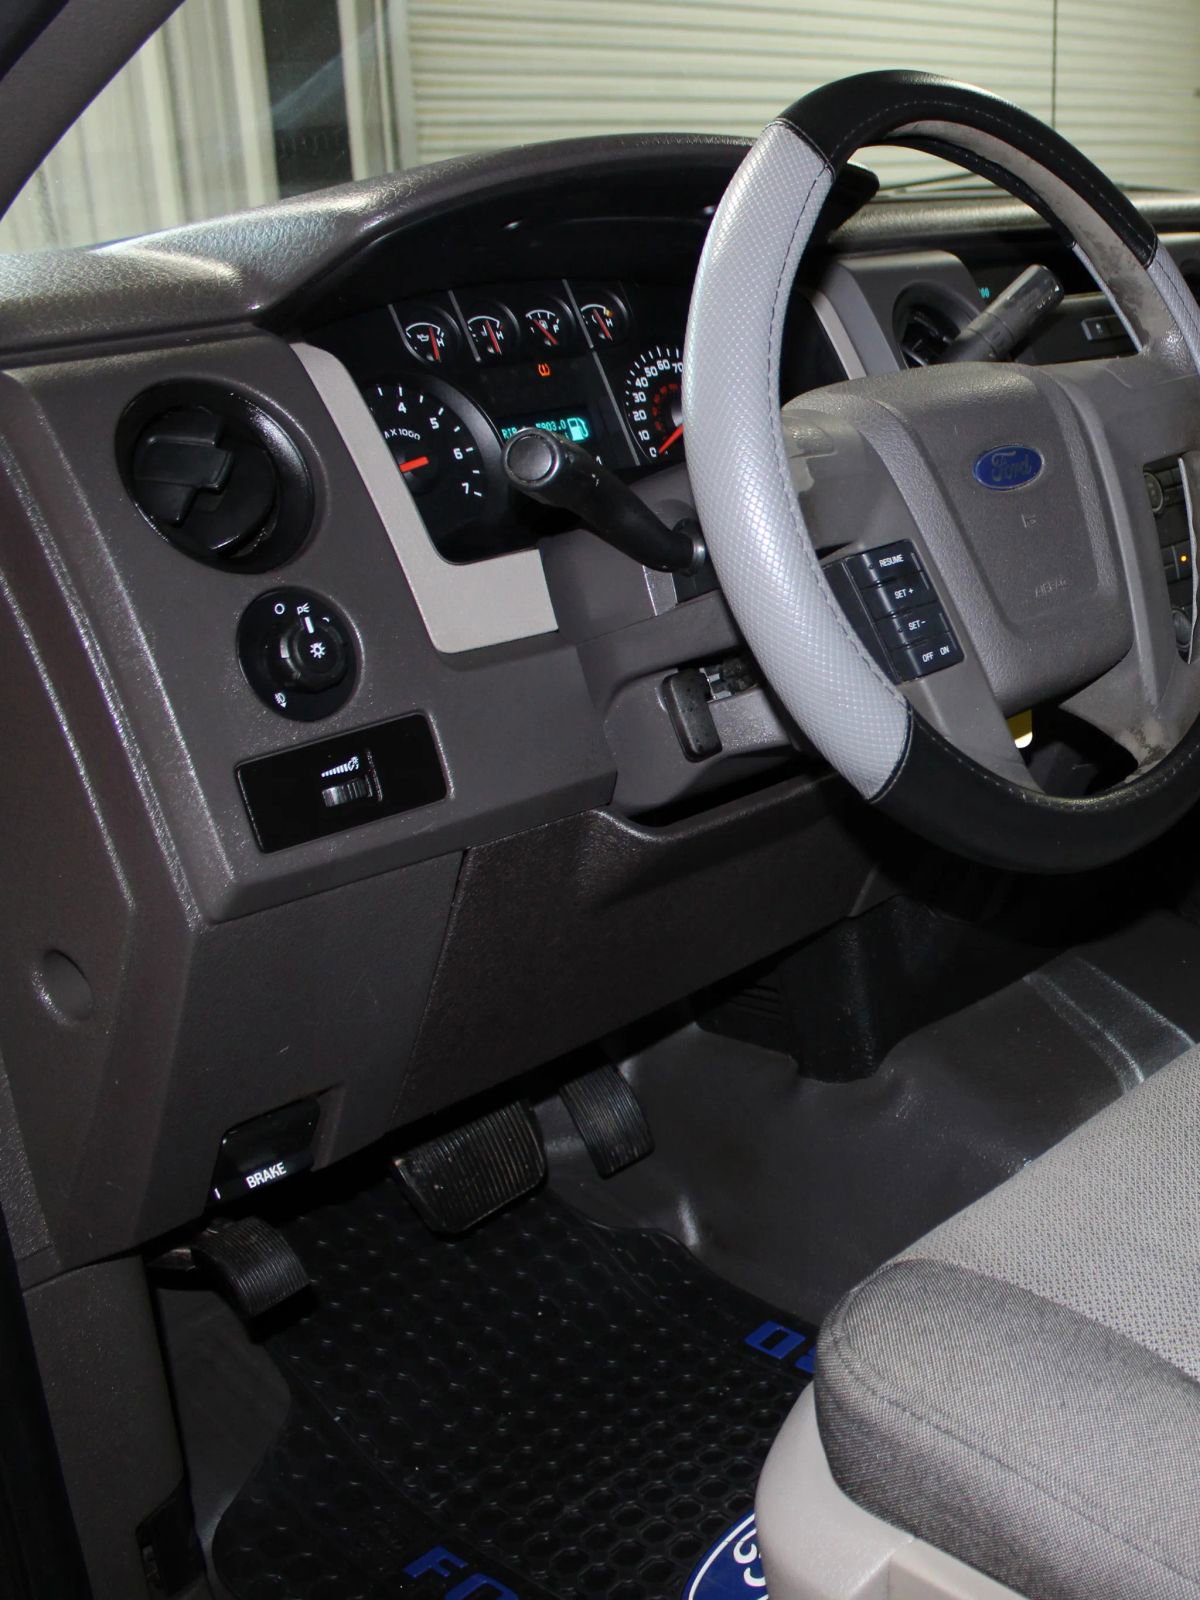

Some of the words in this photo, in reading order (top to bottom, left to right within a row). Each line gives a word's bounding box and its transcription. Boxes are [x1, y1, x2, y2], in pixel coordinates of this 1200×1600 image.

[605, 318, 613, 327] H
[496, 331, 504, 341] H
[436, 338, 444, 348] H
[656, 359, 670, 371] 60
[672, 362, 684, 374] 70
[644, 366, 658, 378] 50
[635, 377, 648, 388] 40
[632, 391, 646, 403] 30
[398, 402, 407, 414] 4
[632, 409, 647, 421] 20
[429, 417, 440, 430] 5
[638, 429, 650, 441] 10
[453, 448, 463, 460] 6
[649, 447, 657, 458] 0
[991, 450, 1032, 482] Ford
[461, 482, 470, 494] 7
[879, 554, 905, 568] RESUME
[894, 588, 907, 600] SET
[908, 619, 921, 631] SET
[922, 651, 934, 663] OFF
[940, 645, 950, 656] ON
[246, 1161, 287, 1189] BRAKE
